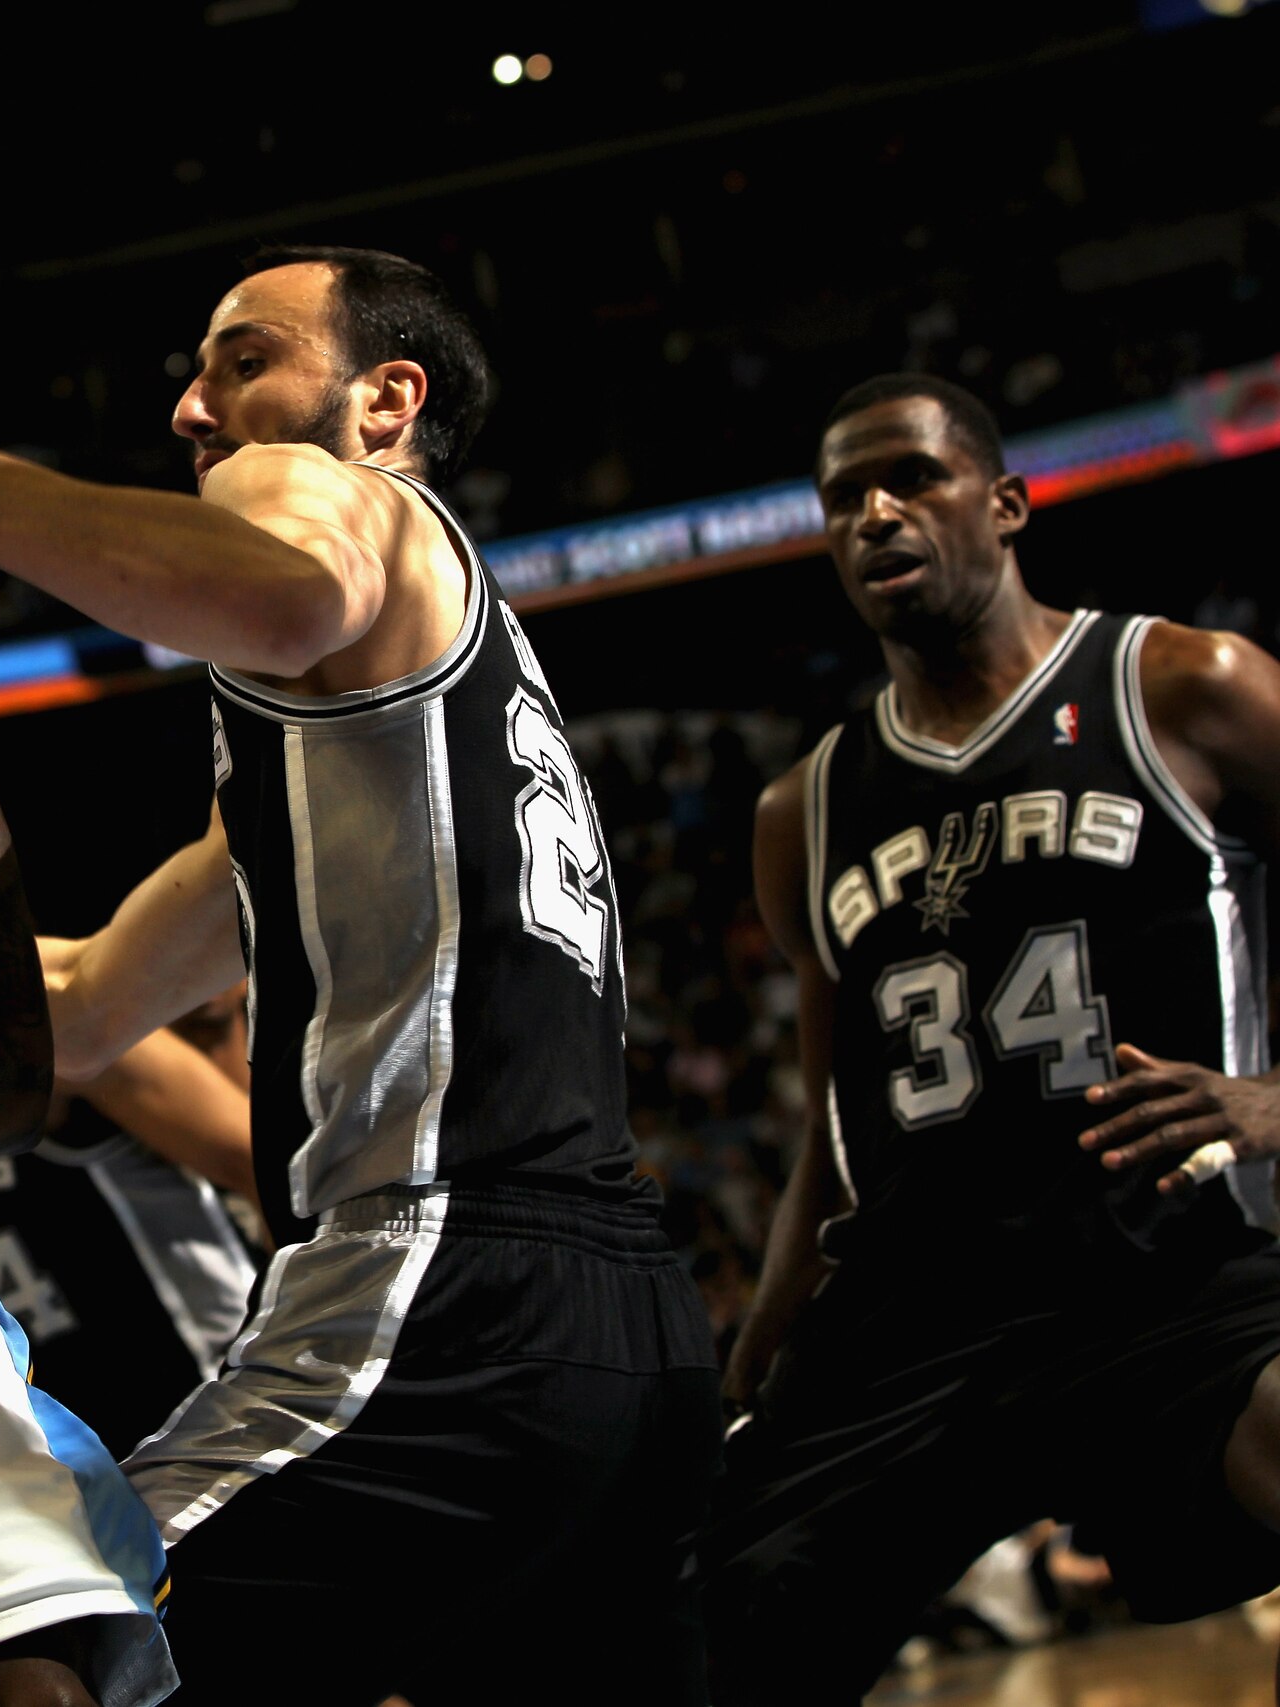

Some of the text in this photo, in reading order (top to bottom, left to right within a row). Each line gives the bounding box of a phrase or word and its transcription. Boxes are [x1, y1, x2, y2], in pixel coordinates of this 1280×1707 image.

[505, 684, 626, 1040] 2
[828, 790, 1144, 950] SPURS
[872, 918, 1118, 1132] 34
